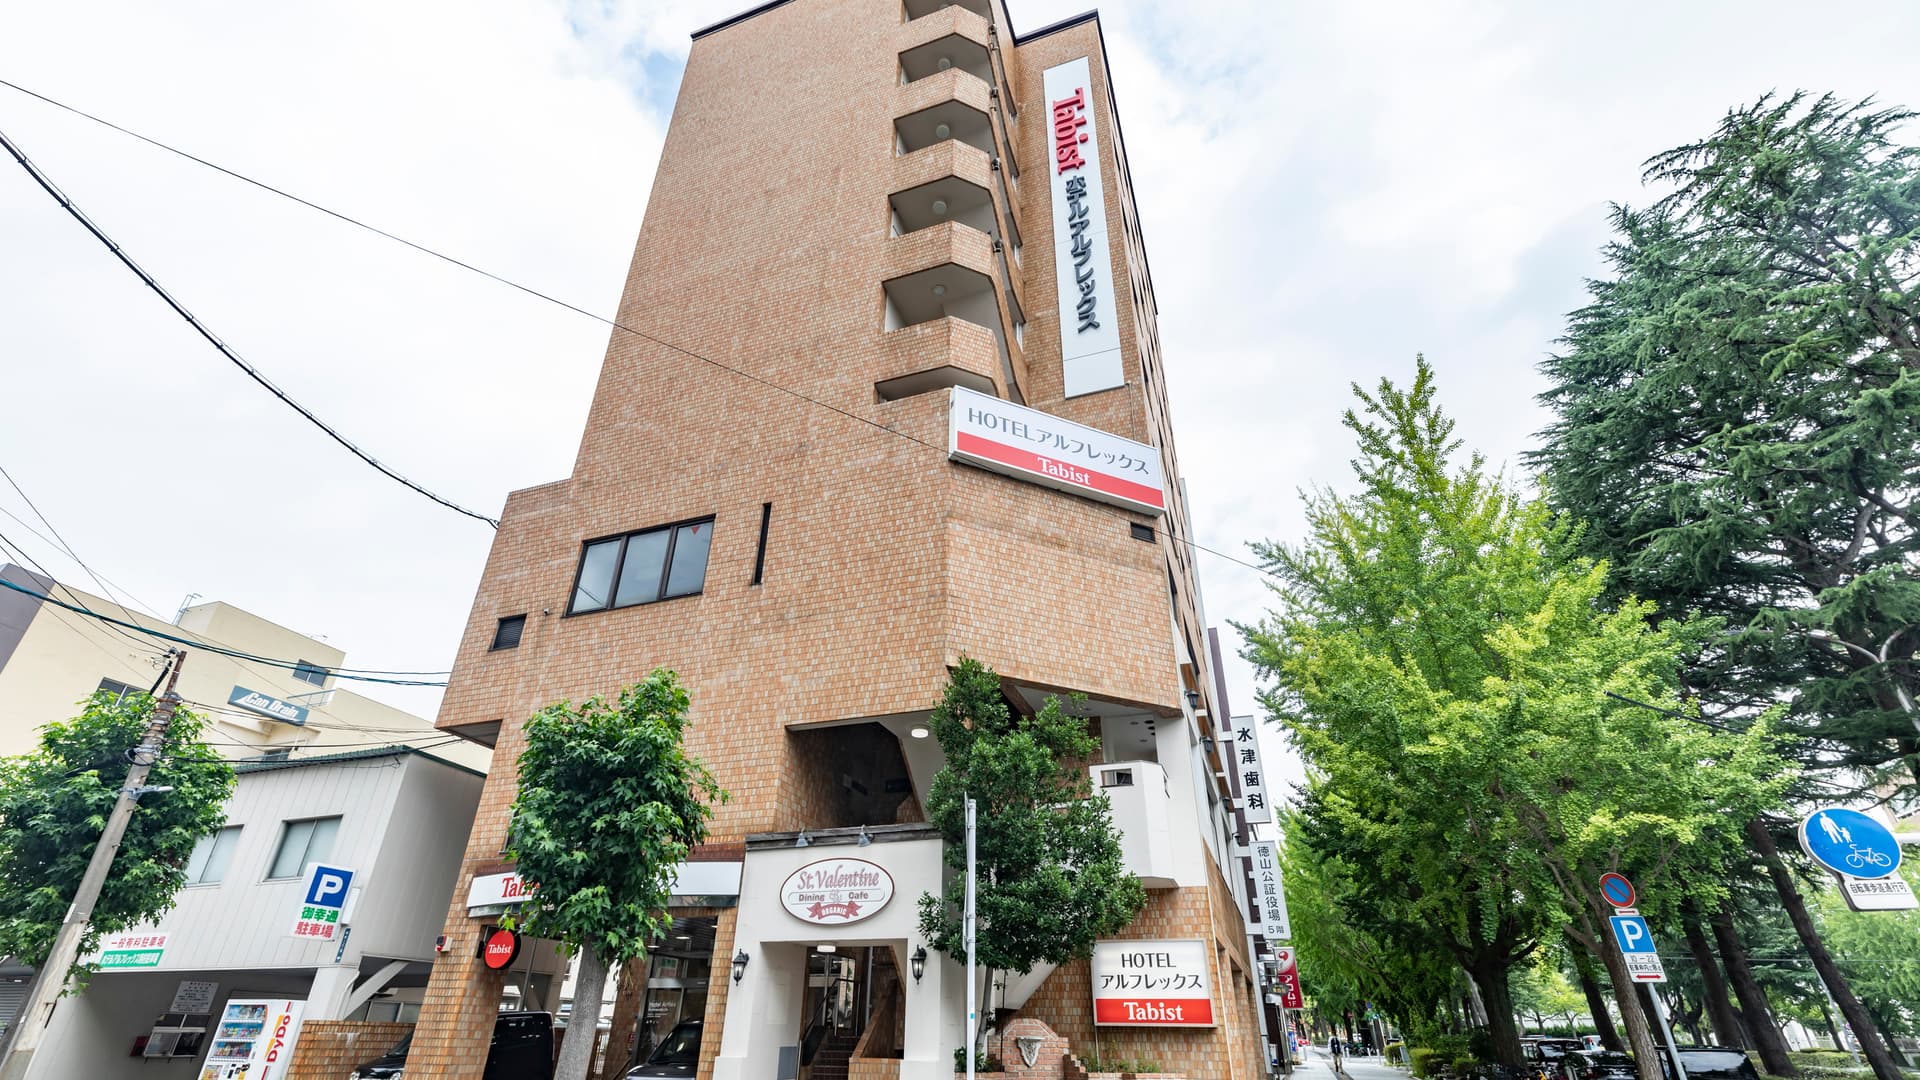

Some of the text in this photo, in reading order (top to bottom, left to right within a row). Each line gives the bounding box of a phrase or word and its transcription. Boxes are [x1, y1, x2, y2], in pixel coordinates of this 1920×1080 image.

[1053, 87, 1088, 175] Tabist
[1066, 175, 1100, 334] ホテルアルフレックス
[1037, 457, 1091, 485] Tabist
[1237, 727, 1264, 809] 水津歯科
[313, 874, 343, 902] P
[1257, 846, 1280, 921] 徳山公証役場
[799, 891, 869, 902] Dining Cafe
[301, 907, 339, 923] 御幸通
[821, 906, 847, 916] ORGANIC
[295, 921, 334, 938] 駐車場
[1620, 920, 1643, 949] P
[111, 936, 166, 948] 一般有料駐車場
[489, 944, 512, 954] Tabist
[1121, 953, 1176, 968] HOTEL
[1100, 973, 1202, 990] アルフレックス
[1123, 1001, 1183, 1021] Tabist
[267, 1015, 291, 1063] DyDo
